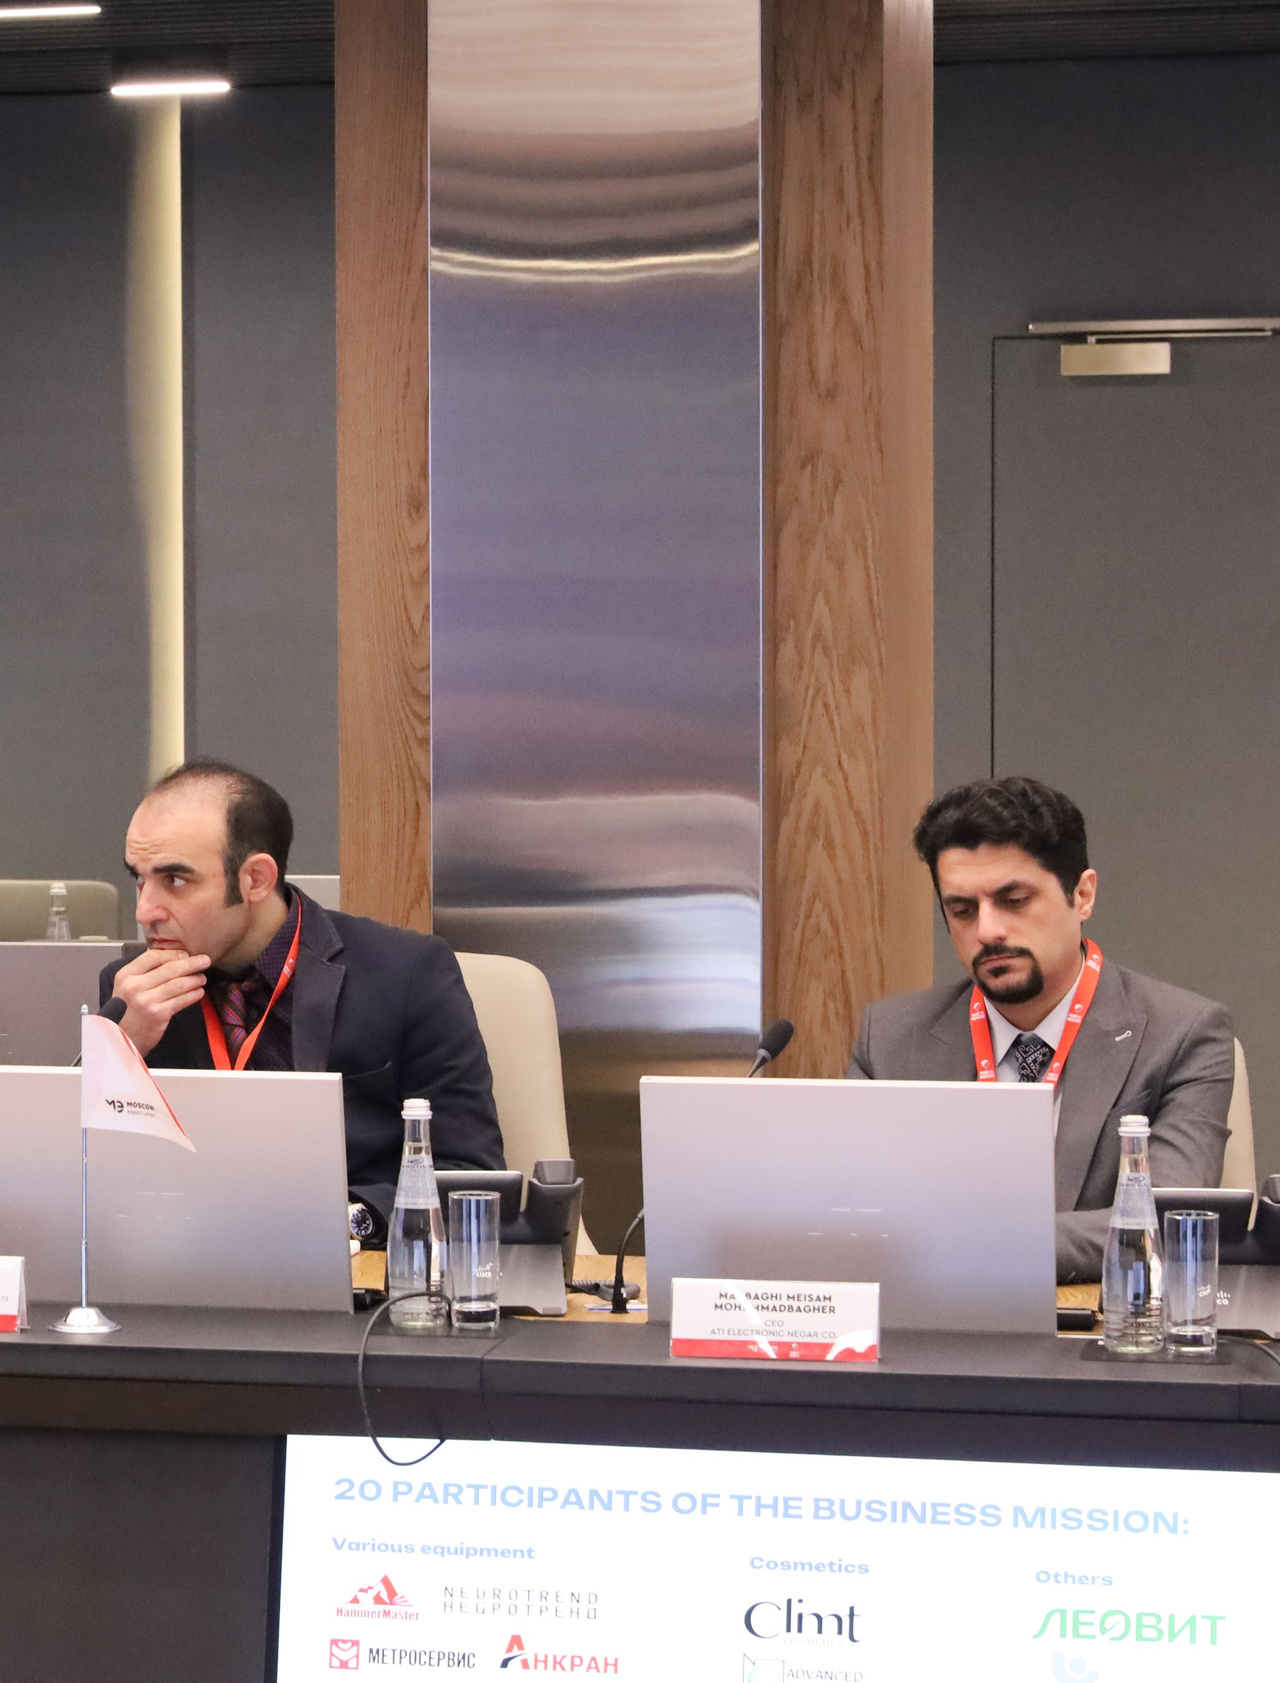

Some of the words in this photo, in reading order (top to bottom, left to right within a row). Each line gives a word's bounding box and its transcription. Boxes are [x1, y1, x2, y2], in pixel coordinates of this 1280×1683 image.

[126, 1101, 155, 1111] MOSCOW
[719, 1291, 782, 1301] MABAGHI
[786, 1294, 832, 1303] MEISAM
[714, 1302, 836, 1314] MOHMMADBAGHER
[764, 1319, 785, 1328] CEO
[710, 1328, 725, 1336] ATI
[727, 1328, 785, 1338] ELECTRONIC
[787, 1330, 819, 1338] NEGAR
[821, 1331, 838, 1339] CO.
[334, 1478, 382, 1502] 20
[392, 1480, 663, 1514] PARTICIPANTS
[671, 1491, 721, 1516] OF
[729, 1494, 804, 1520] THE
[812, 1498, 1002, 1528] BUSINESS
[1012, 1506, 1190, 1536] MISSION:
[332, 1537, 416, 1555] Various
[420, 1541, 536, 1560] equipment
[749, 1556, 870, 1576] Cosmetics
[1034, 1570, 1114, 1587] Others
[444, 1586, 598, 1605] NEUROTREND
[336, 1606, 420, 1622] HammerMaster
[744, 1598, 863, 1643] Climt
[1033, 1608, 1227, 1646] ЛЕОВИТ
[368, 1648, 476, 1670] МЕТРОСЕРВИС
[786, 1668, 864, 1682] ADVANCED
